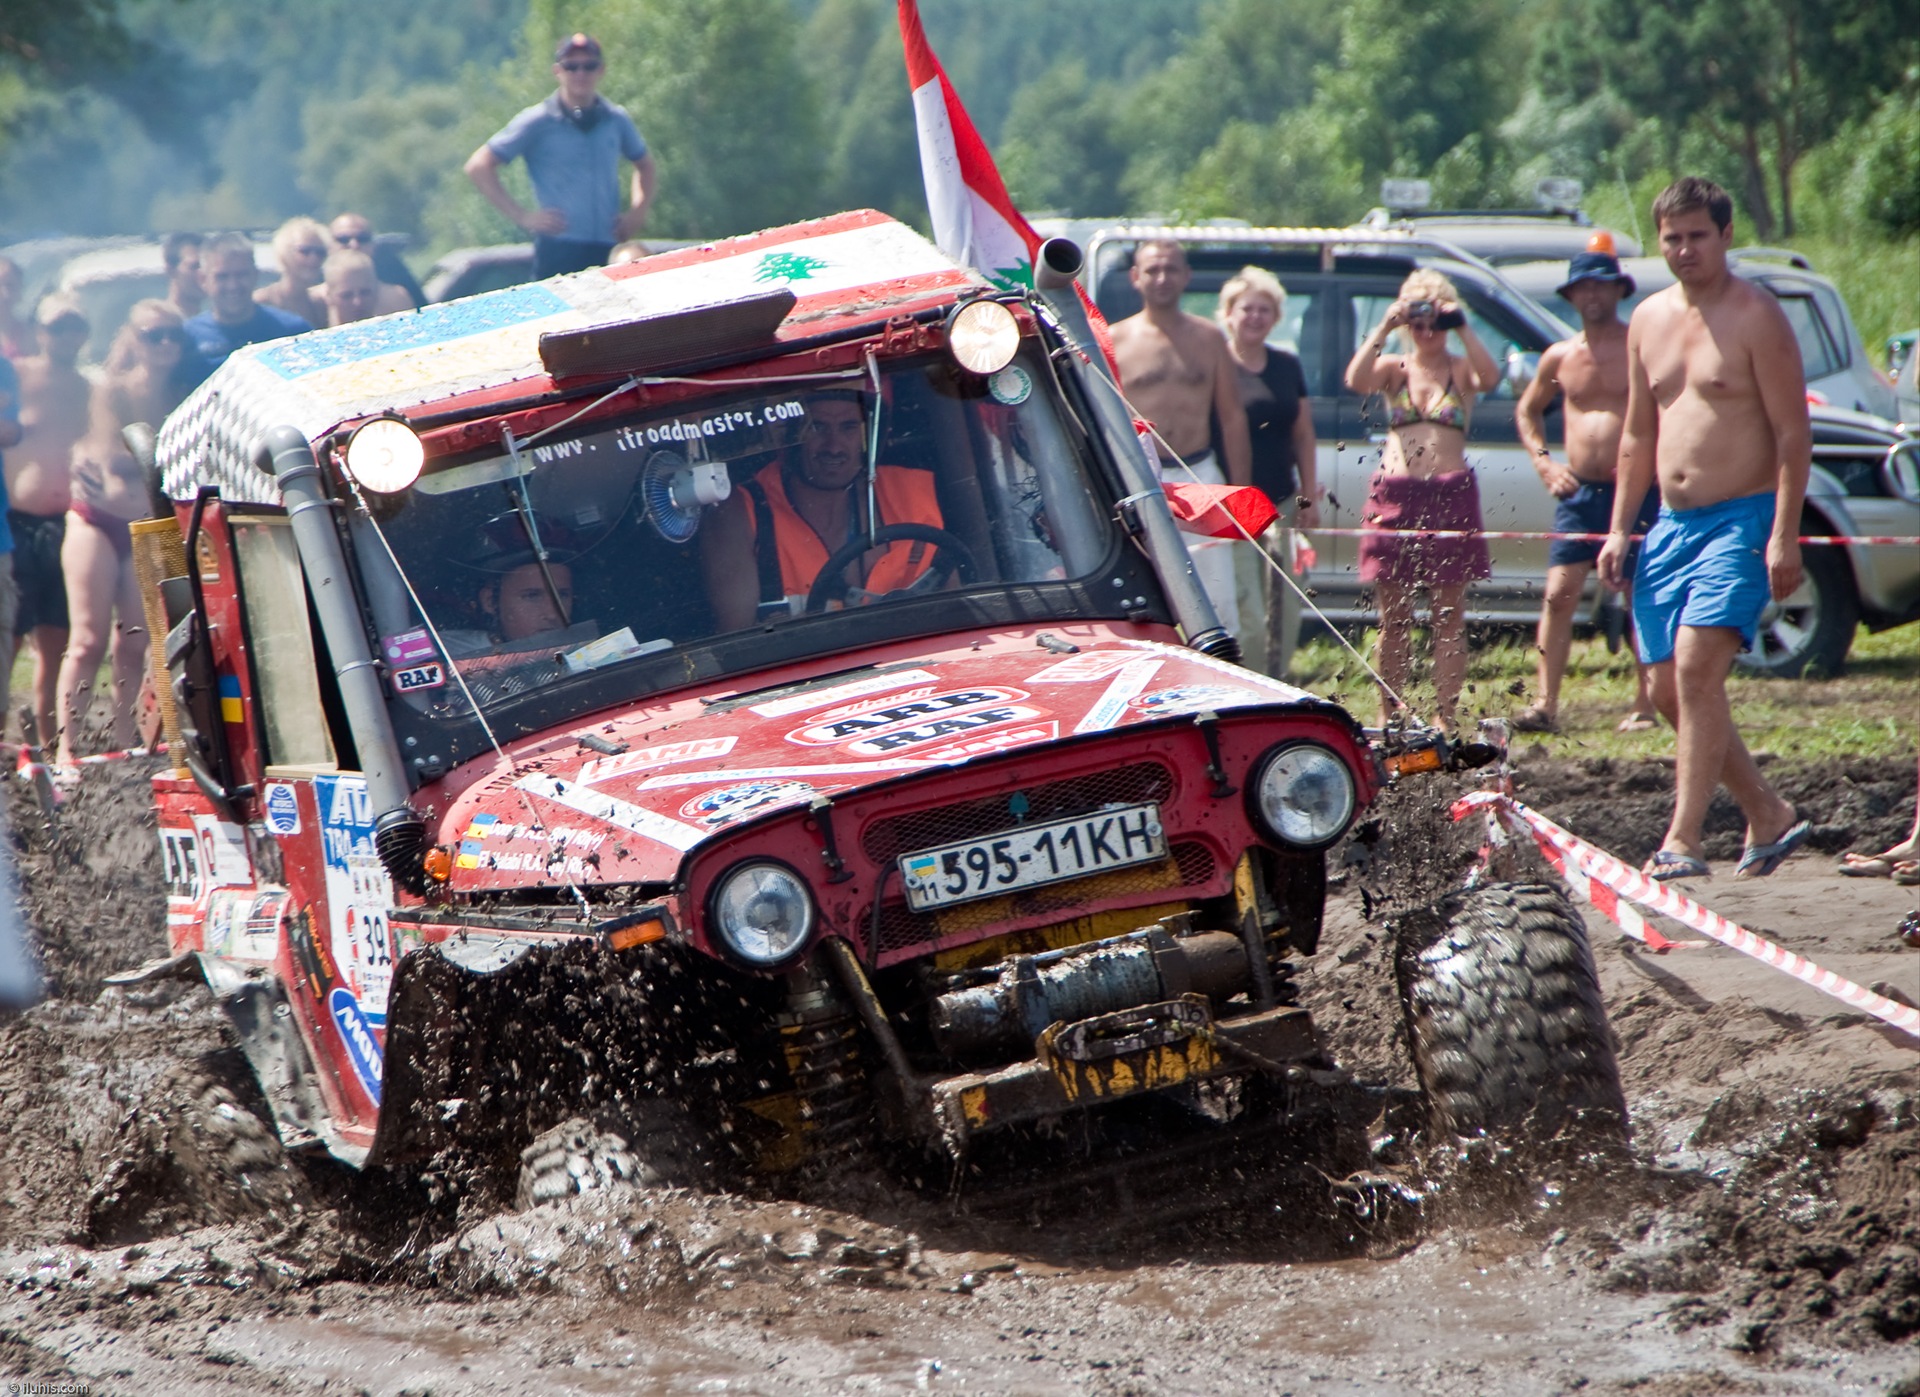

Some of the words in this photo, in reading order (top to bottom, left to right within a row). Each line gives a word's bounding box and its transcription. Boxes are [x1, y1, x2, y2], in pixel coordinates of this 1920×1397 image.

[822, 692, 1000, 737] ARB
[862, 707, 1016, 751] RAF
[588, 739, 726, 778] FIAMM
[925, 729, 1048, 760] WARN
[941, 811, 1153, 895] 595-11KH
[919, 882, 940, 901] 11
[363, 915, 392, 967] 39
